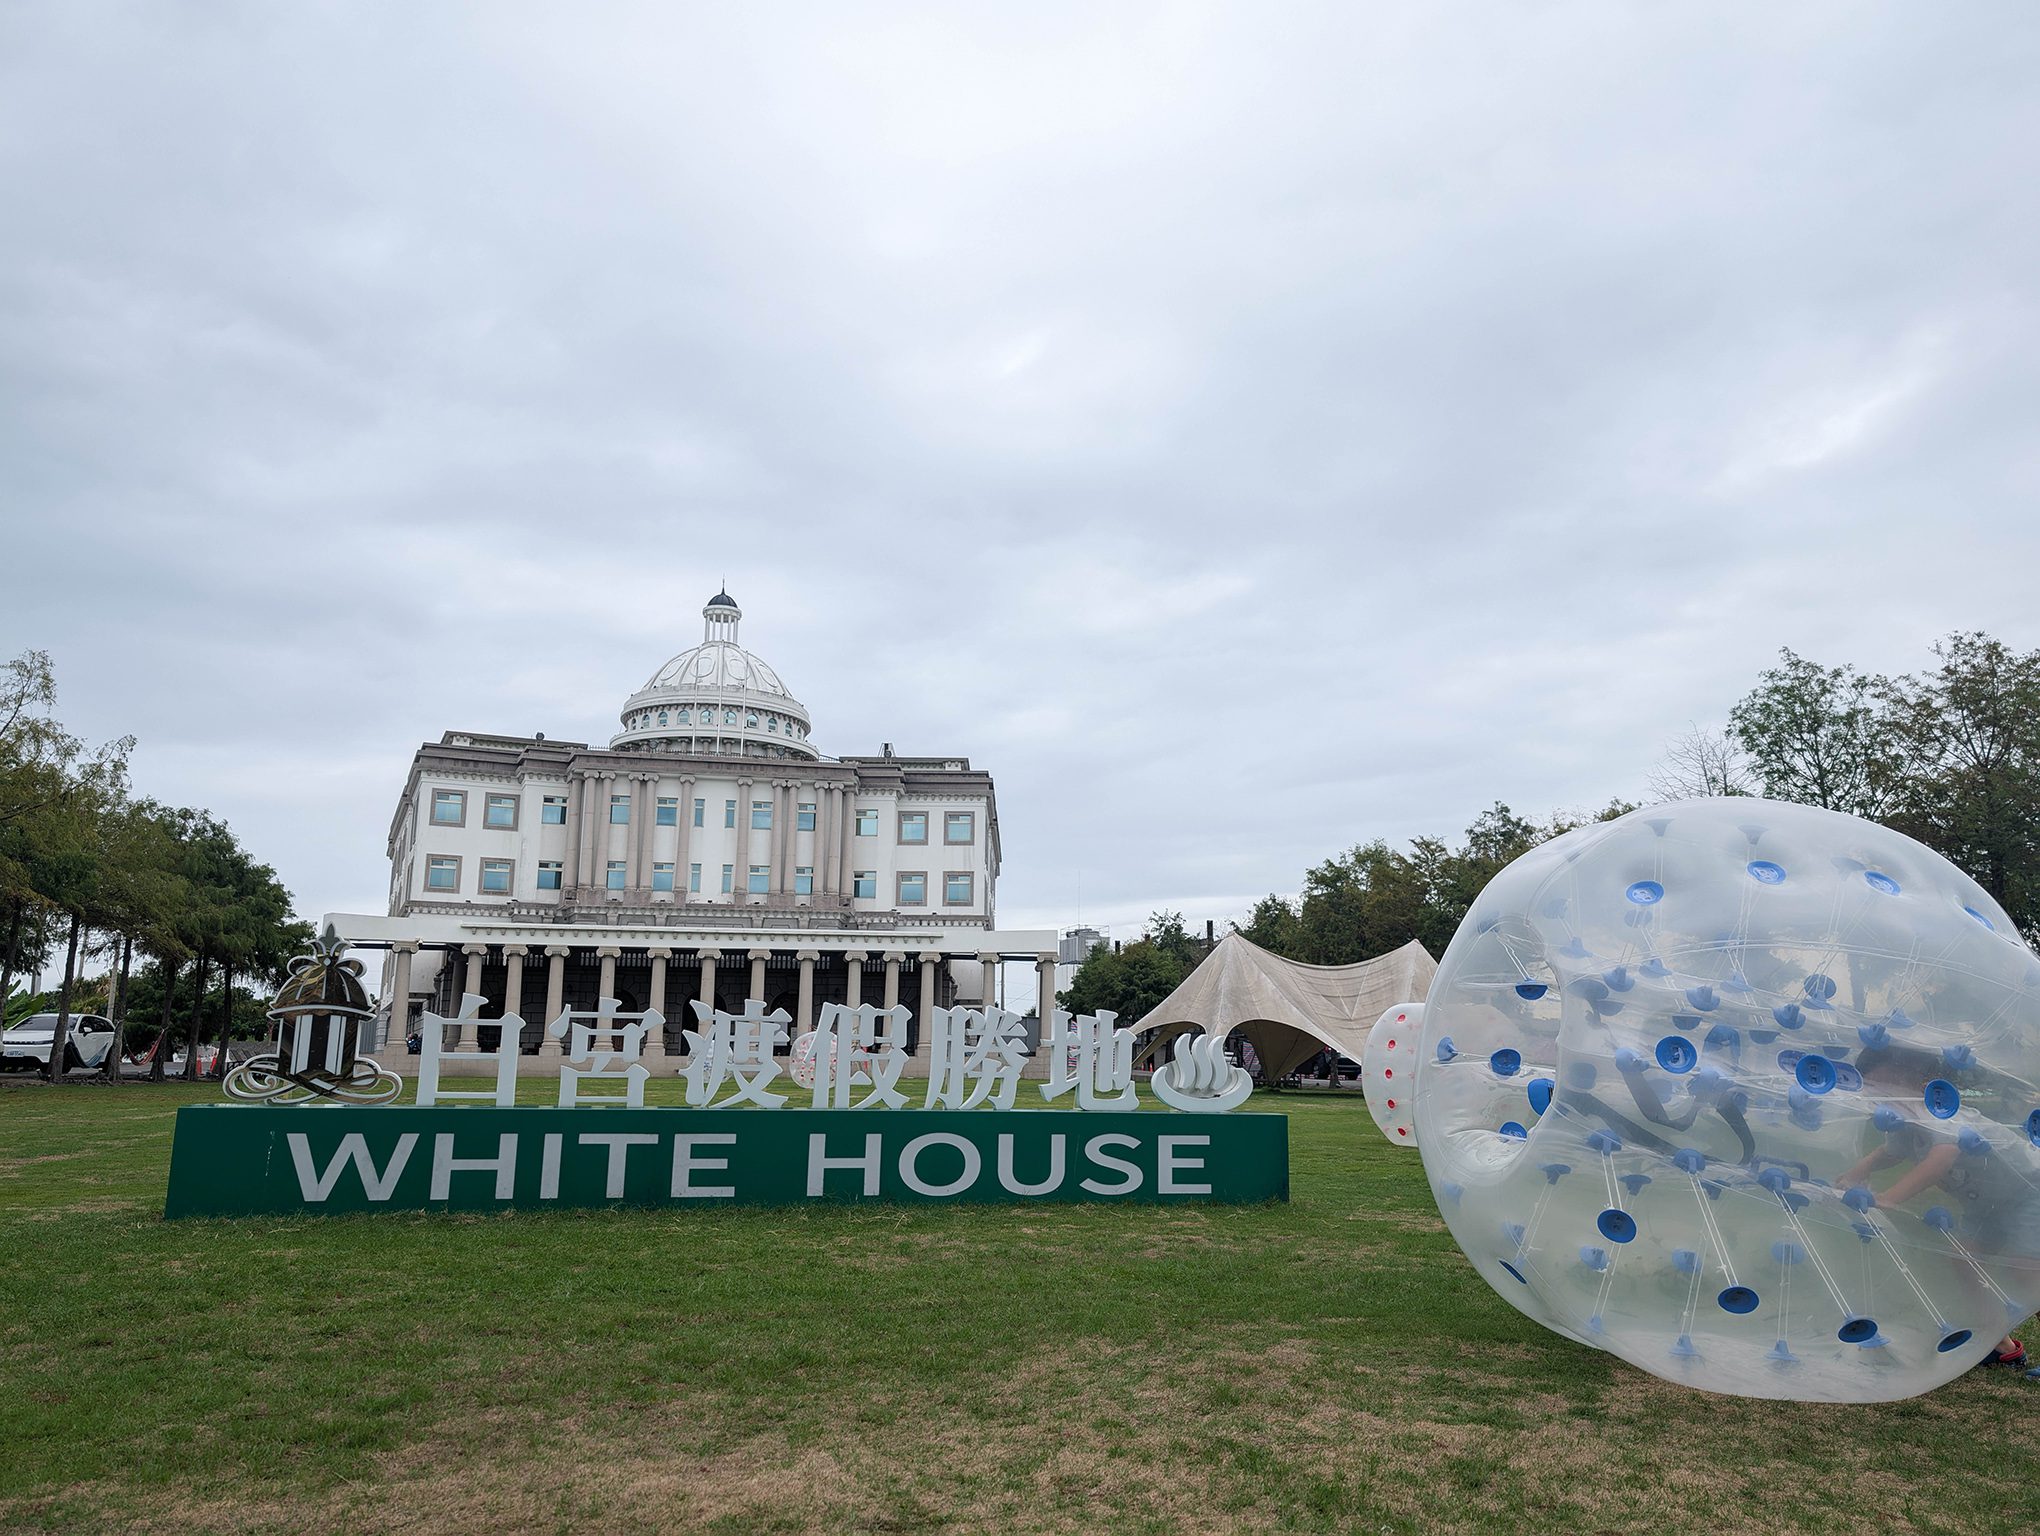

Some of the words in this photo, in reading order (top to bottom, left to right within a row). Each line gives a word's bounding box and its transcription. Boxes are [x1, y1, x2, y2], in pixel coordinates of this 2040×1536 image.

[416, 992, 1140, 1110] 白宮渡假勝地
[286, 1133, 738, 1202] WHITE
[806, 1132, 1213, 1197] HOUSE
